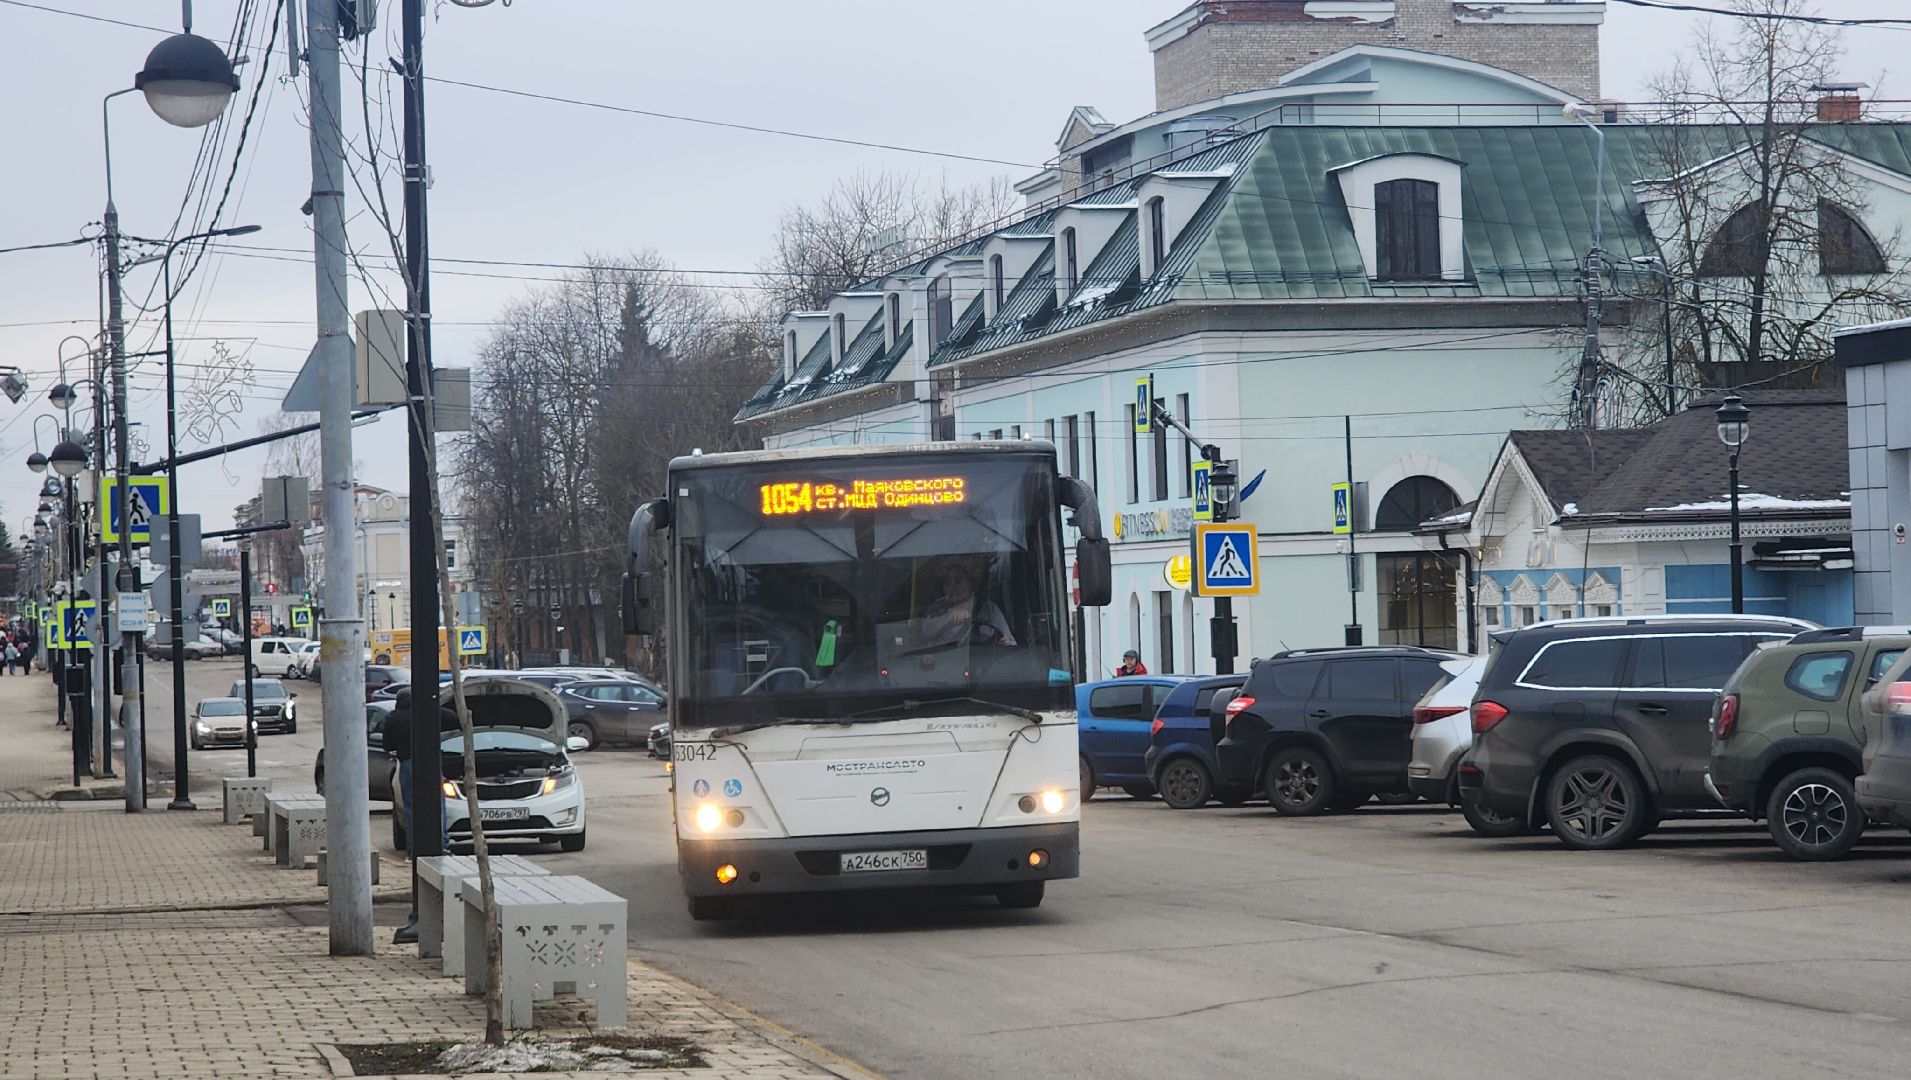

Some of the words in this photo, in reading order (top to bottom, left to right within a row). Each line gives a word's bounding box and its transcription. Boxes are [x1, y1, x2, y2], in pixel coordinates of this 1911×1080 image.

[815, 484, 844, 496] кв.
[854, 478, 964, 494] Маяковского
[761, 483, 812, 514] 1054
[884, 490, 964, 507] Одинцово
[827, 760, 925, 772] МОСТРАНСАВТО
[846, 854, 899, 871] А246СК
[901, 851, 922, 864] 750
